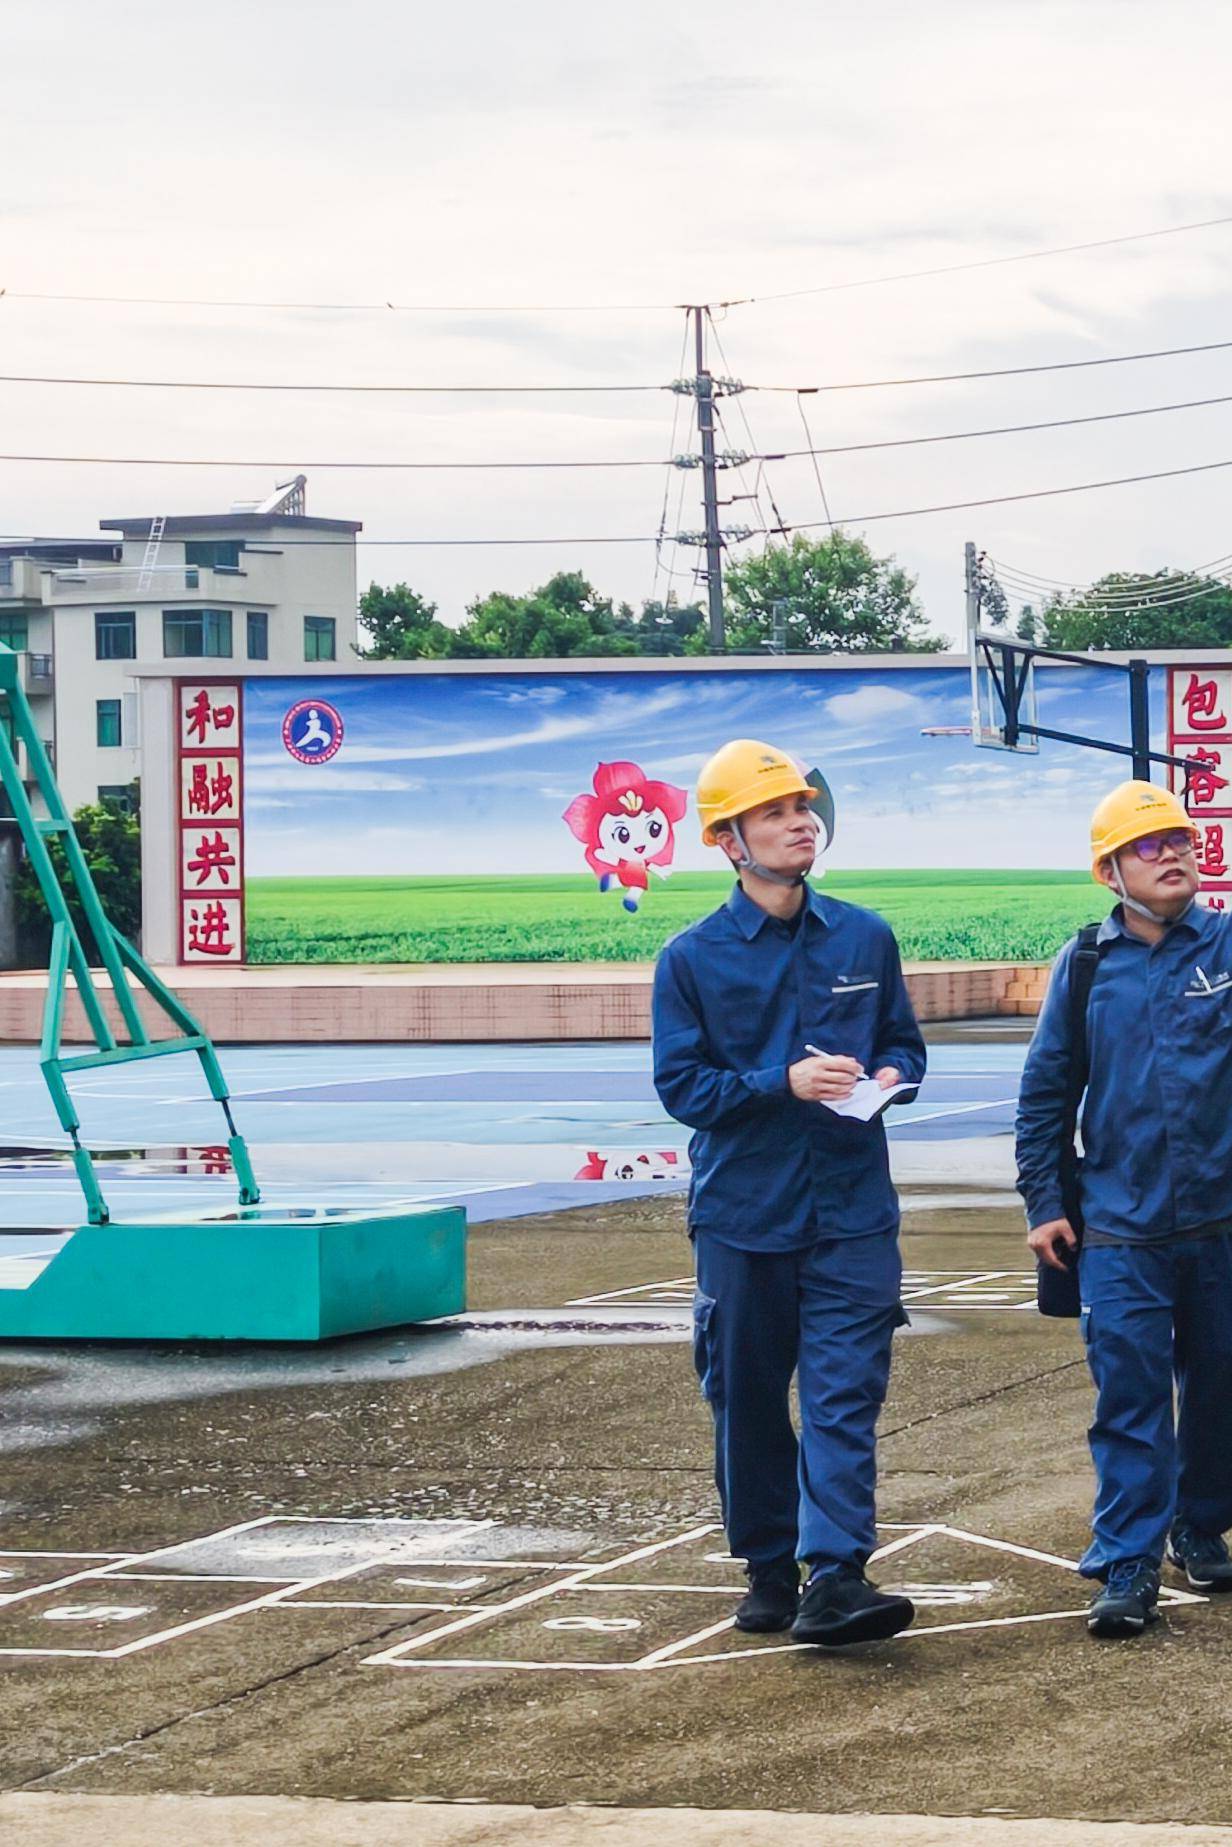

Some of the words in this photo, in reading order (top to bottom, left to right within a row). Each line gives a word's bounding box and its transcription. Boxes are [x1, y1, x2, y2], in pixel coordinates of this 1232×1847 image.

[186, 689, 236, 955] 和融共进
[1181, 673, 1229, 913] 包容超
[541, 1616, 642, 1632] 8
